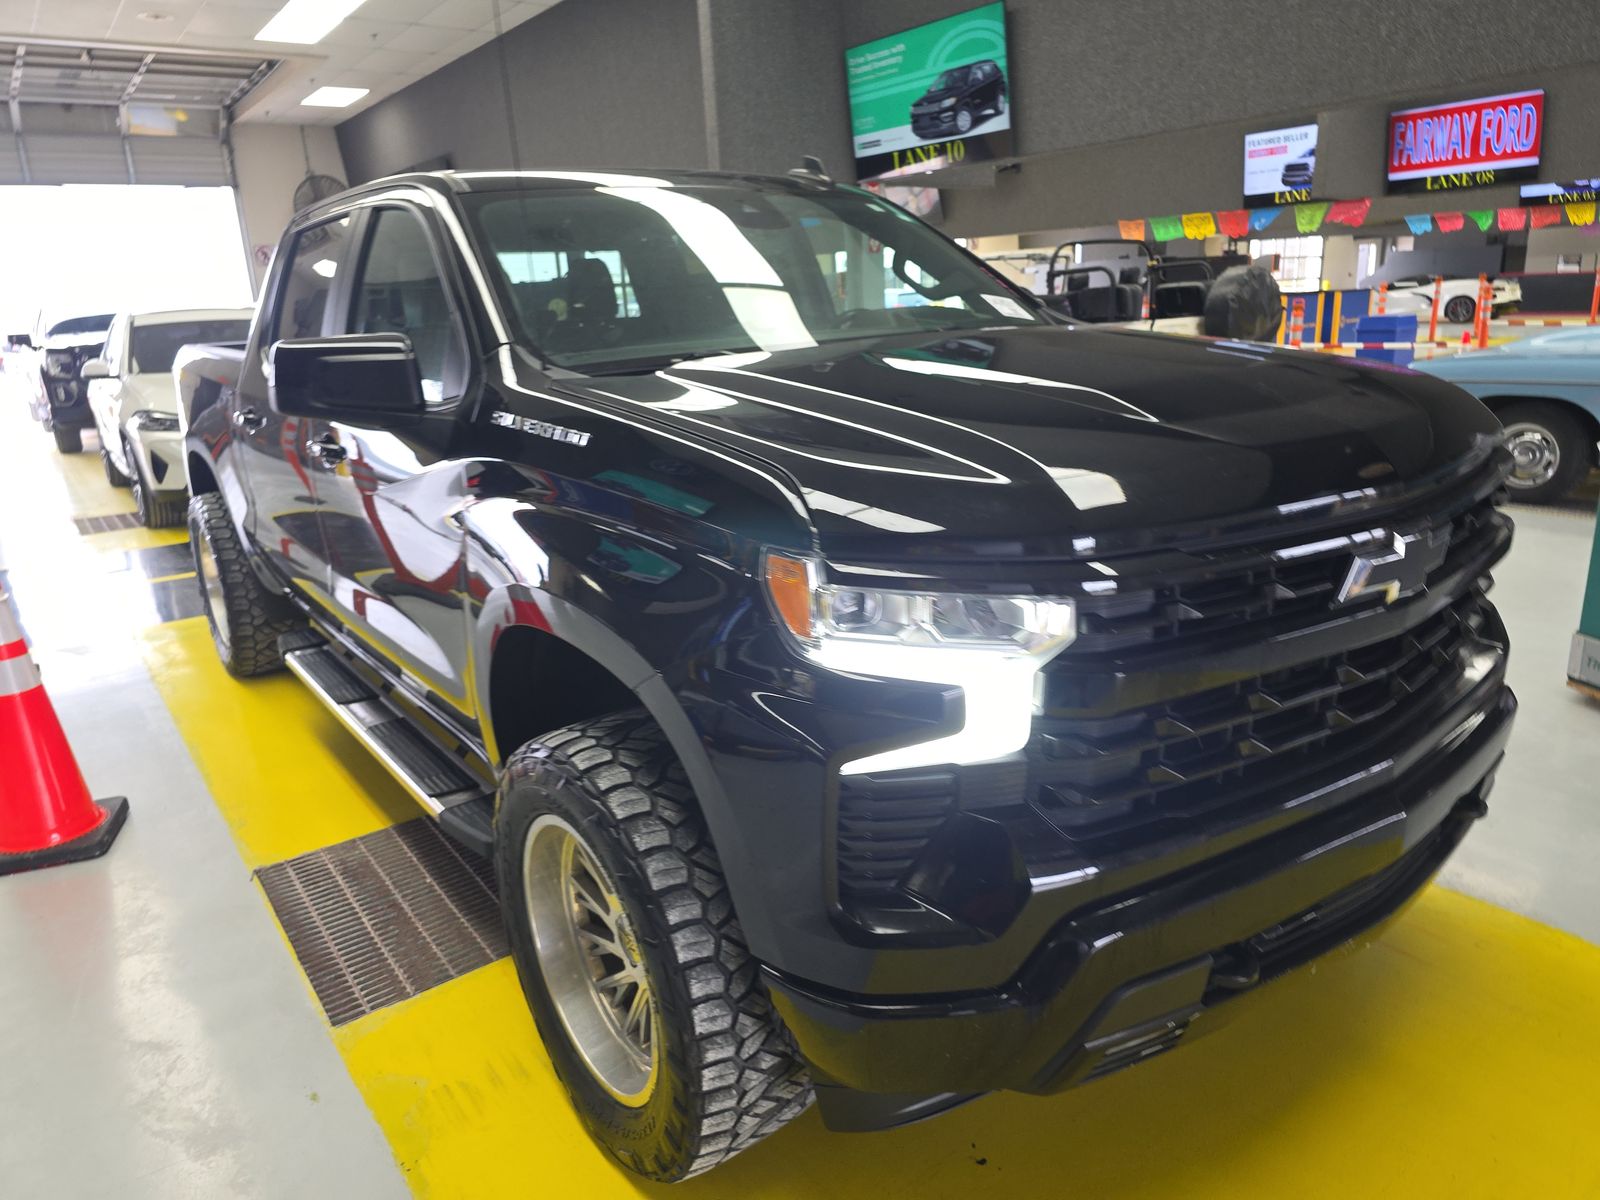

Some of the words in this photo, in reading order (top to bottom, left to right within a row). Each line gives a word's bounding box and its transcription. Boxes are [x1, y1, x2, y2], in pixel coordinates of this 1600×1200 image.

[1392, 110, 1477, 167] FAIRWAY
[1479, 103, 1537, 157] FORD
[892, 143, 940, 171] LANE
[946, 140, 965, 164] 10
[1426, 171, 1474, 191] LANE
[1475, 168, 1495, 185] 08
[1274, 187, 1311, 205] LANE
[1548, 191, 1581, 205] LANE
